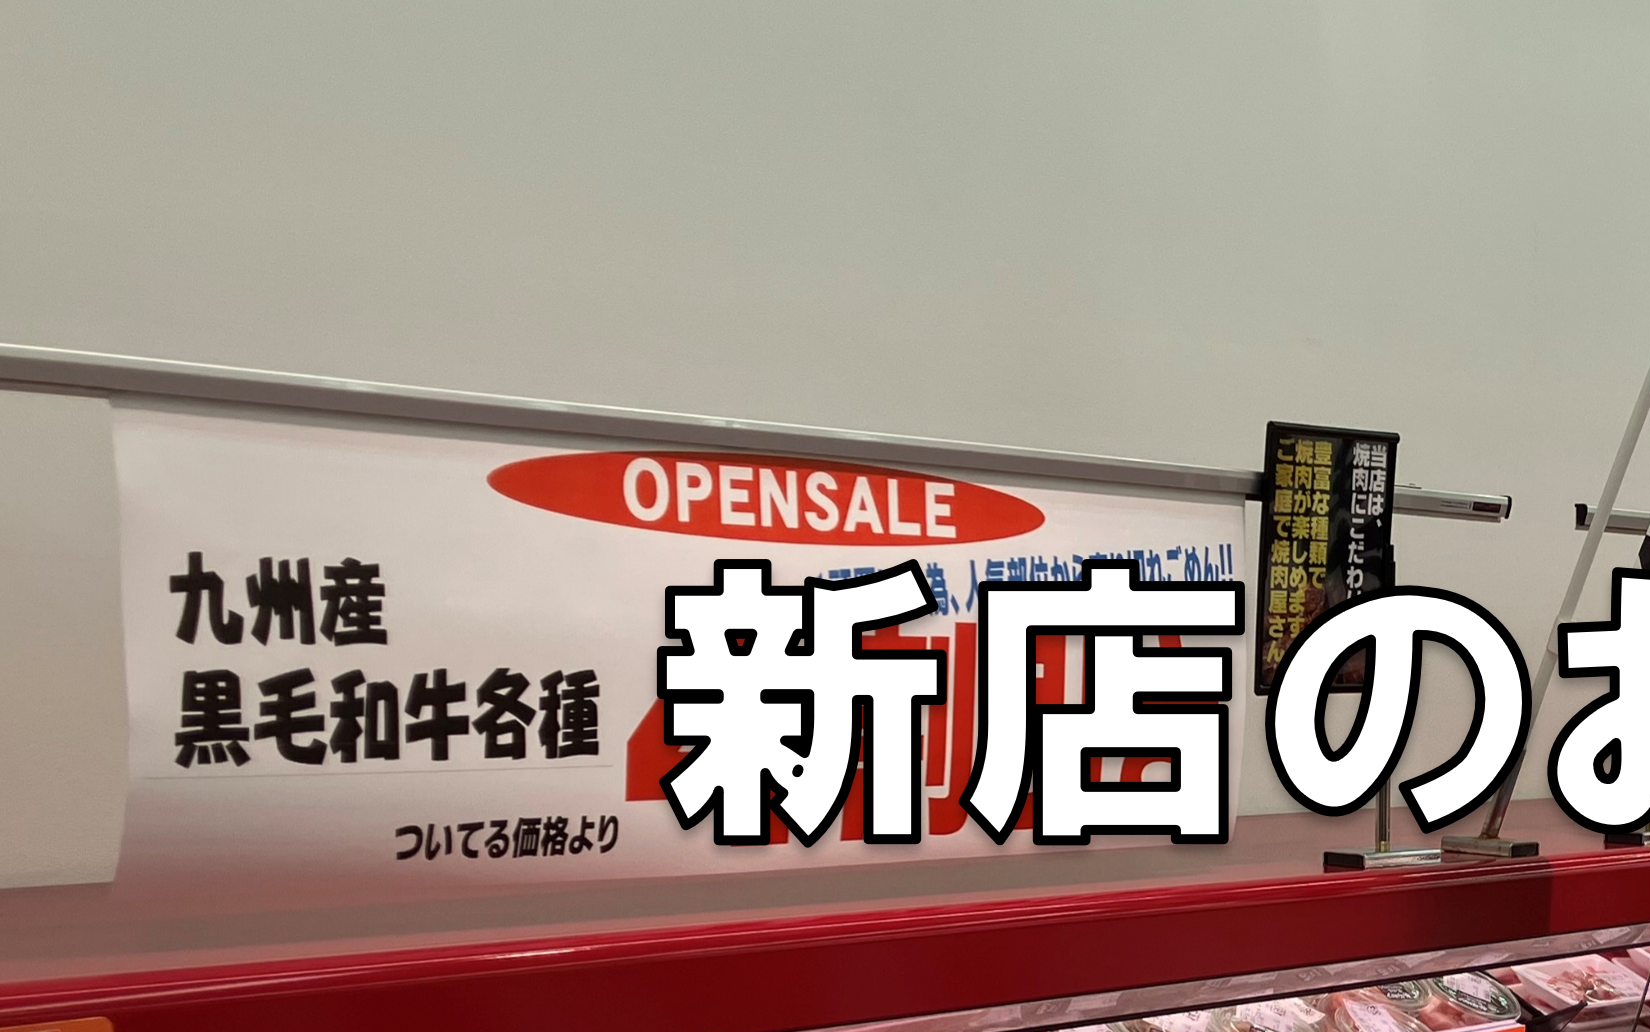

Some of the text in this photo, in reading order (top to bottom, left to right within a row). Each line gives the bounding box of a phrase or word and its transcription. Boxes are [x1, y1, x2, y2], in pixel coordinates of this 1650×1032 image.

[622, 456, 957, 539] OPENSALE
[1309, 441, 1333, 589] 豊富な種類で
[1346, 443, 1370, 601] 焼肉にこだわ
[1367, 444, 1388, 528] 当店は、
[1266, 438, 1295, 663] ご家庭で焼肉屋さん
[1287, 440, 1313, 639] 焼肉が楽しめます
[169, 551, 389, 646] 九州産
[173, 667, 601, 769] 黒毛和牛各種
[394, 815, 620, 861] ついてる価格より
